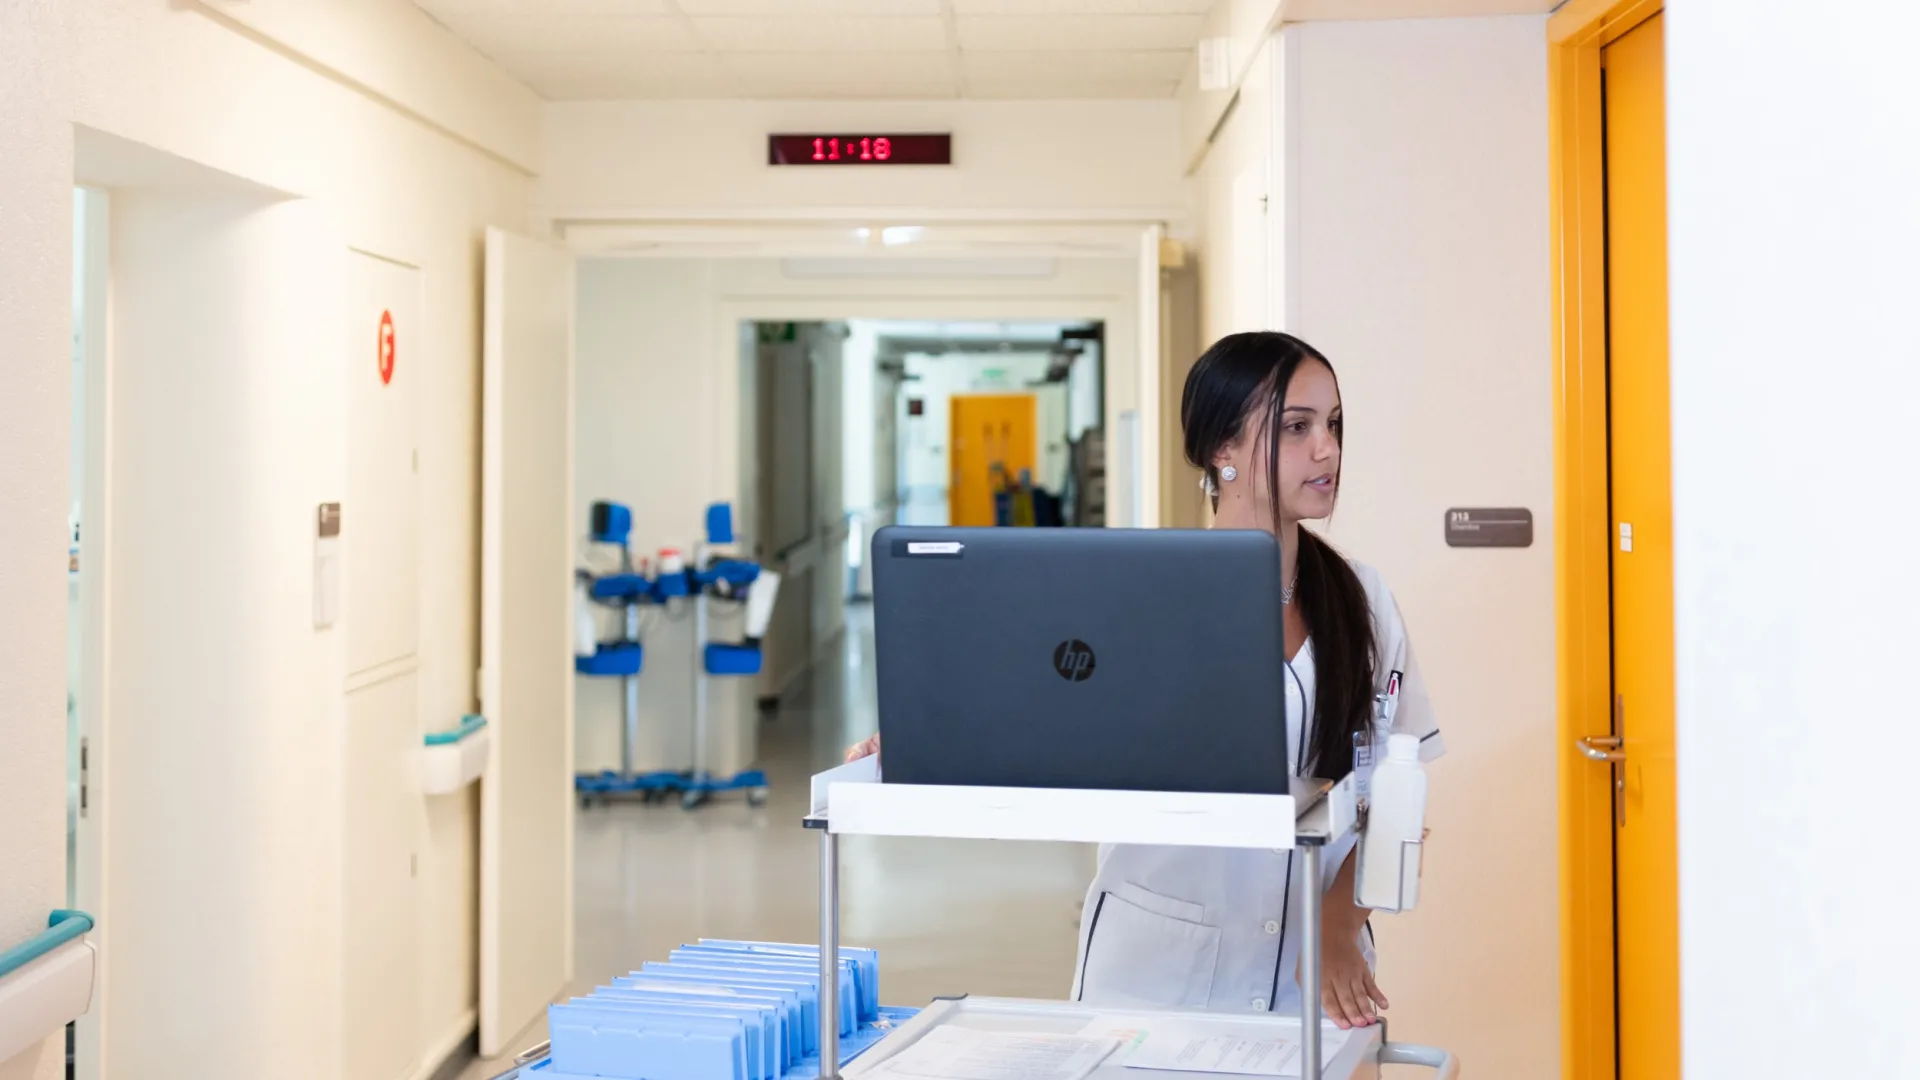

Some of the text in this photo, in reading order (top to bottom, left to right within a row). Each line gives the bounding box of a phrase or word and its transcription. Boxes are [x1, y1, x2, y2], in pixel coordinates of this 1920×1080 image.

[812, 137, 891, 160] 11:18
[381, 323, 393, 370] F
[1060, 640, 1091, 681] hp
